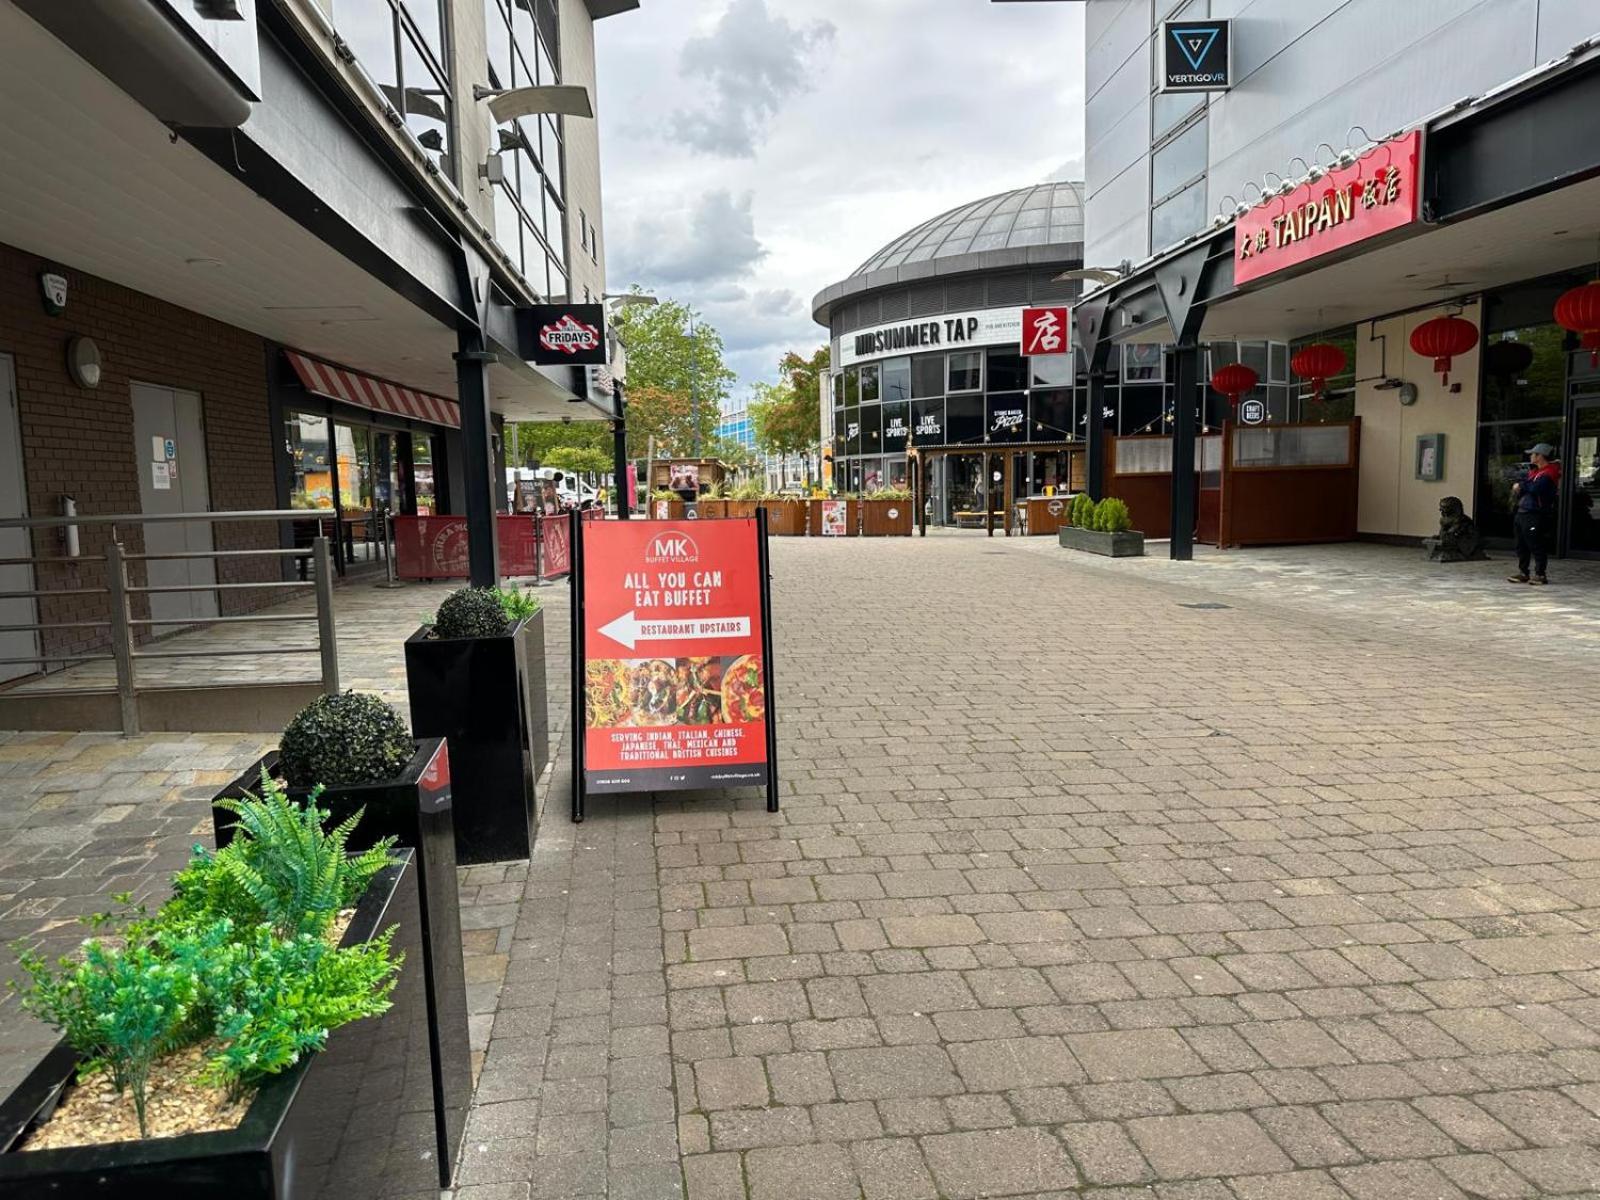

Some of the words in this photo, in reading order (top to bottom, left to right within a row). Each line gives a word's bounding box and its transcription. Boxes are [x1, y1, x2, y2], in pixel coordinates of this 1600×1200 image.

[1168, 73, 1225, 84] VERTIGOVR
[1273, 185, 1354, 248] TAIPAN
[855, 321, 940, 356] MIDSUMMER
[944, 317, 979, 342] TAP
[890, 418, 902, 427] LIVE
[921, 416, 935, 425] LIVE
[990, 414, 1024, 431] Pizza
[886, 427, 907, 437] SPORTS
[916, 424, 940, 434] SPORTS
[655, 539, 688, 556] MK
[624, 572, 649, 589] ALL
[658, 572, 686, 588] YOU
[694, 571, 722, 587] CAN
[636, 590, 659, 606] EAT
[664, 589, 711, 606] BUFFET
[640, 624, 695, 635] RESTAURANT
[700, 622, 741, 633] UPSTAIRS
[611, 732, 643, 742] SERVING
[686, 739, 718, 748] MEXICAN
[722, 738, 737, 746] AND
[620, 751, 669, 760] TRADITIONAL
[672, 749, 701, 758] BRITISH
[706, 748, 738, 757] CUISINES
